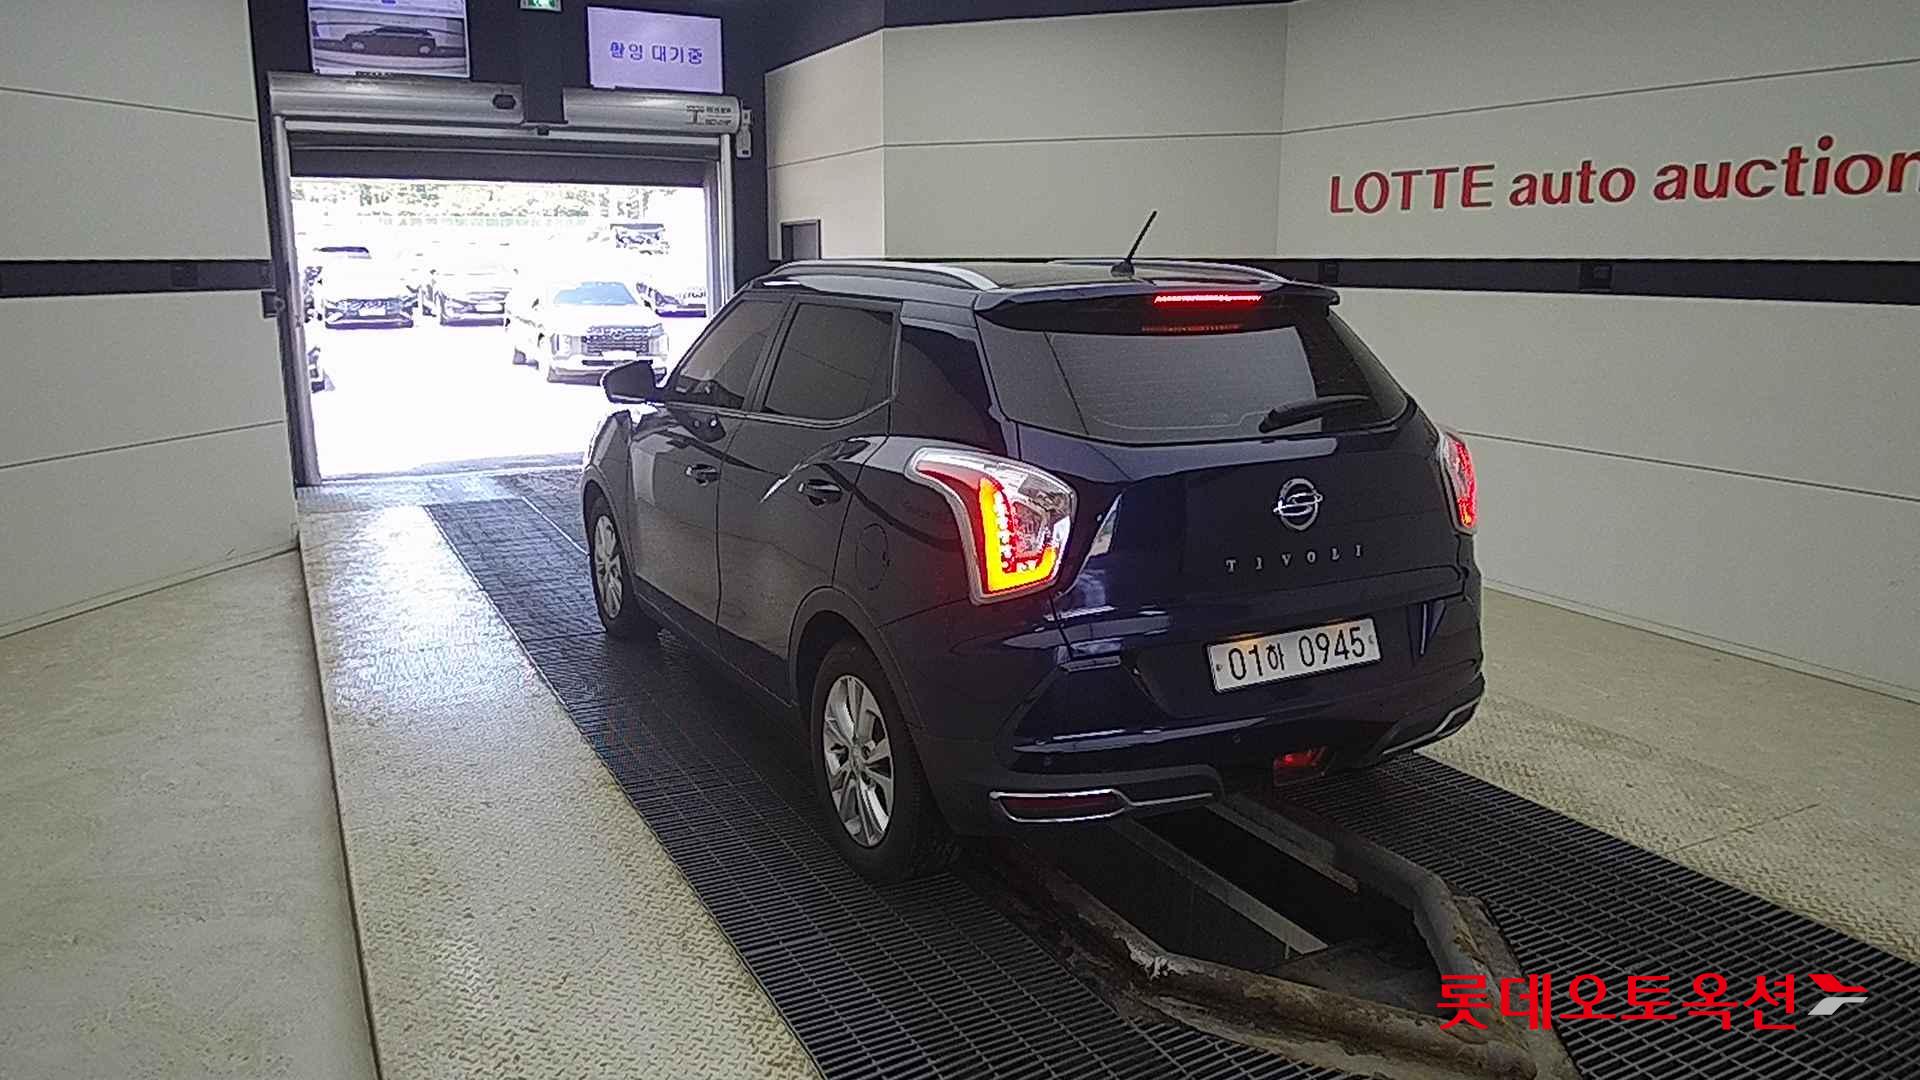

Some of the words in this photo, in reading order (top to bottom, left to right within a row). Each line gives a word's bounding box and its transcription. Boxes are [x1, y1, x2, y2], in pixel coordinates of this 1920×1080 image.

[651, 45, 703, 65] 대기중
[1330, 164, 1495, 213] LOTTE
[1509, 160, 1635, 206] auto
[1226, 544, 1362, 573] TIVOLI
[1227, 643, 1285, 681] 01하
[1298, 626, 1366, 668] 0945
